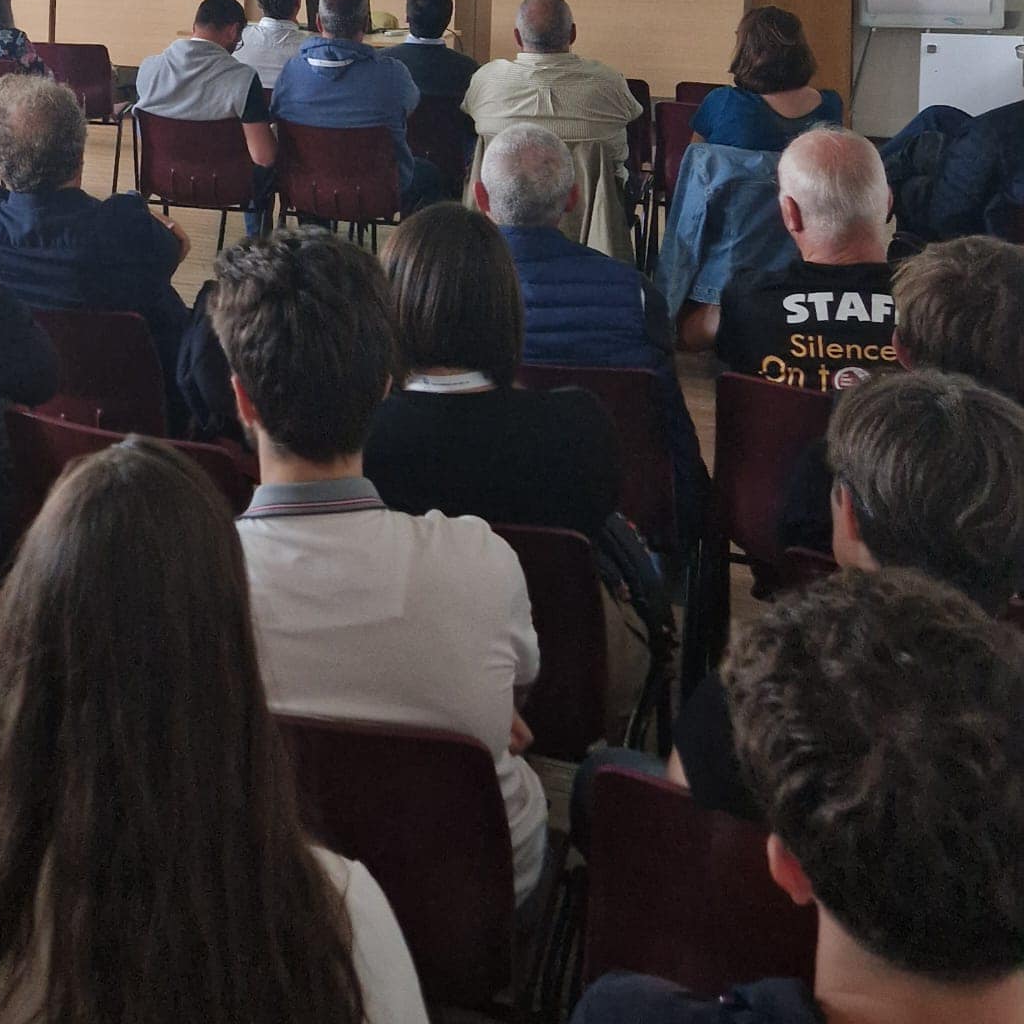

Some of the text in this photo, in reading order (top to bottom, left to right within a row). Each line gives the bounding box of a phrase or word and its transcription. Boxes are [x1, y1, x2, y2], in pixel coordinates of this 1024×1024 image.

[782, 292, 900, 324] STAF
[790, 334, 897, 361] Silence
[759, 355, 805, 390] On
